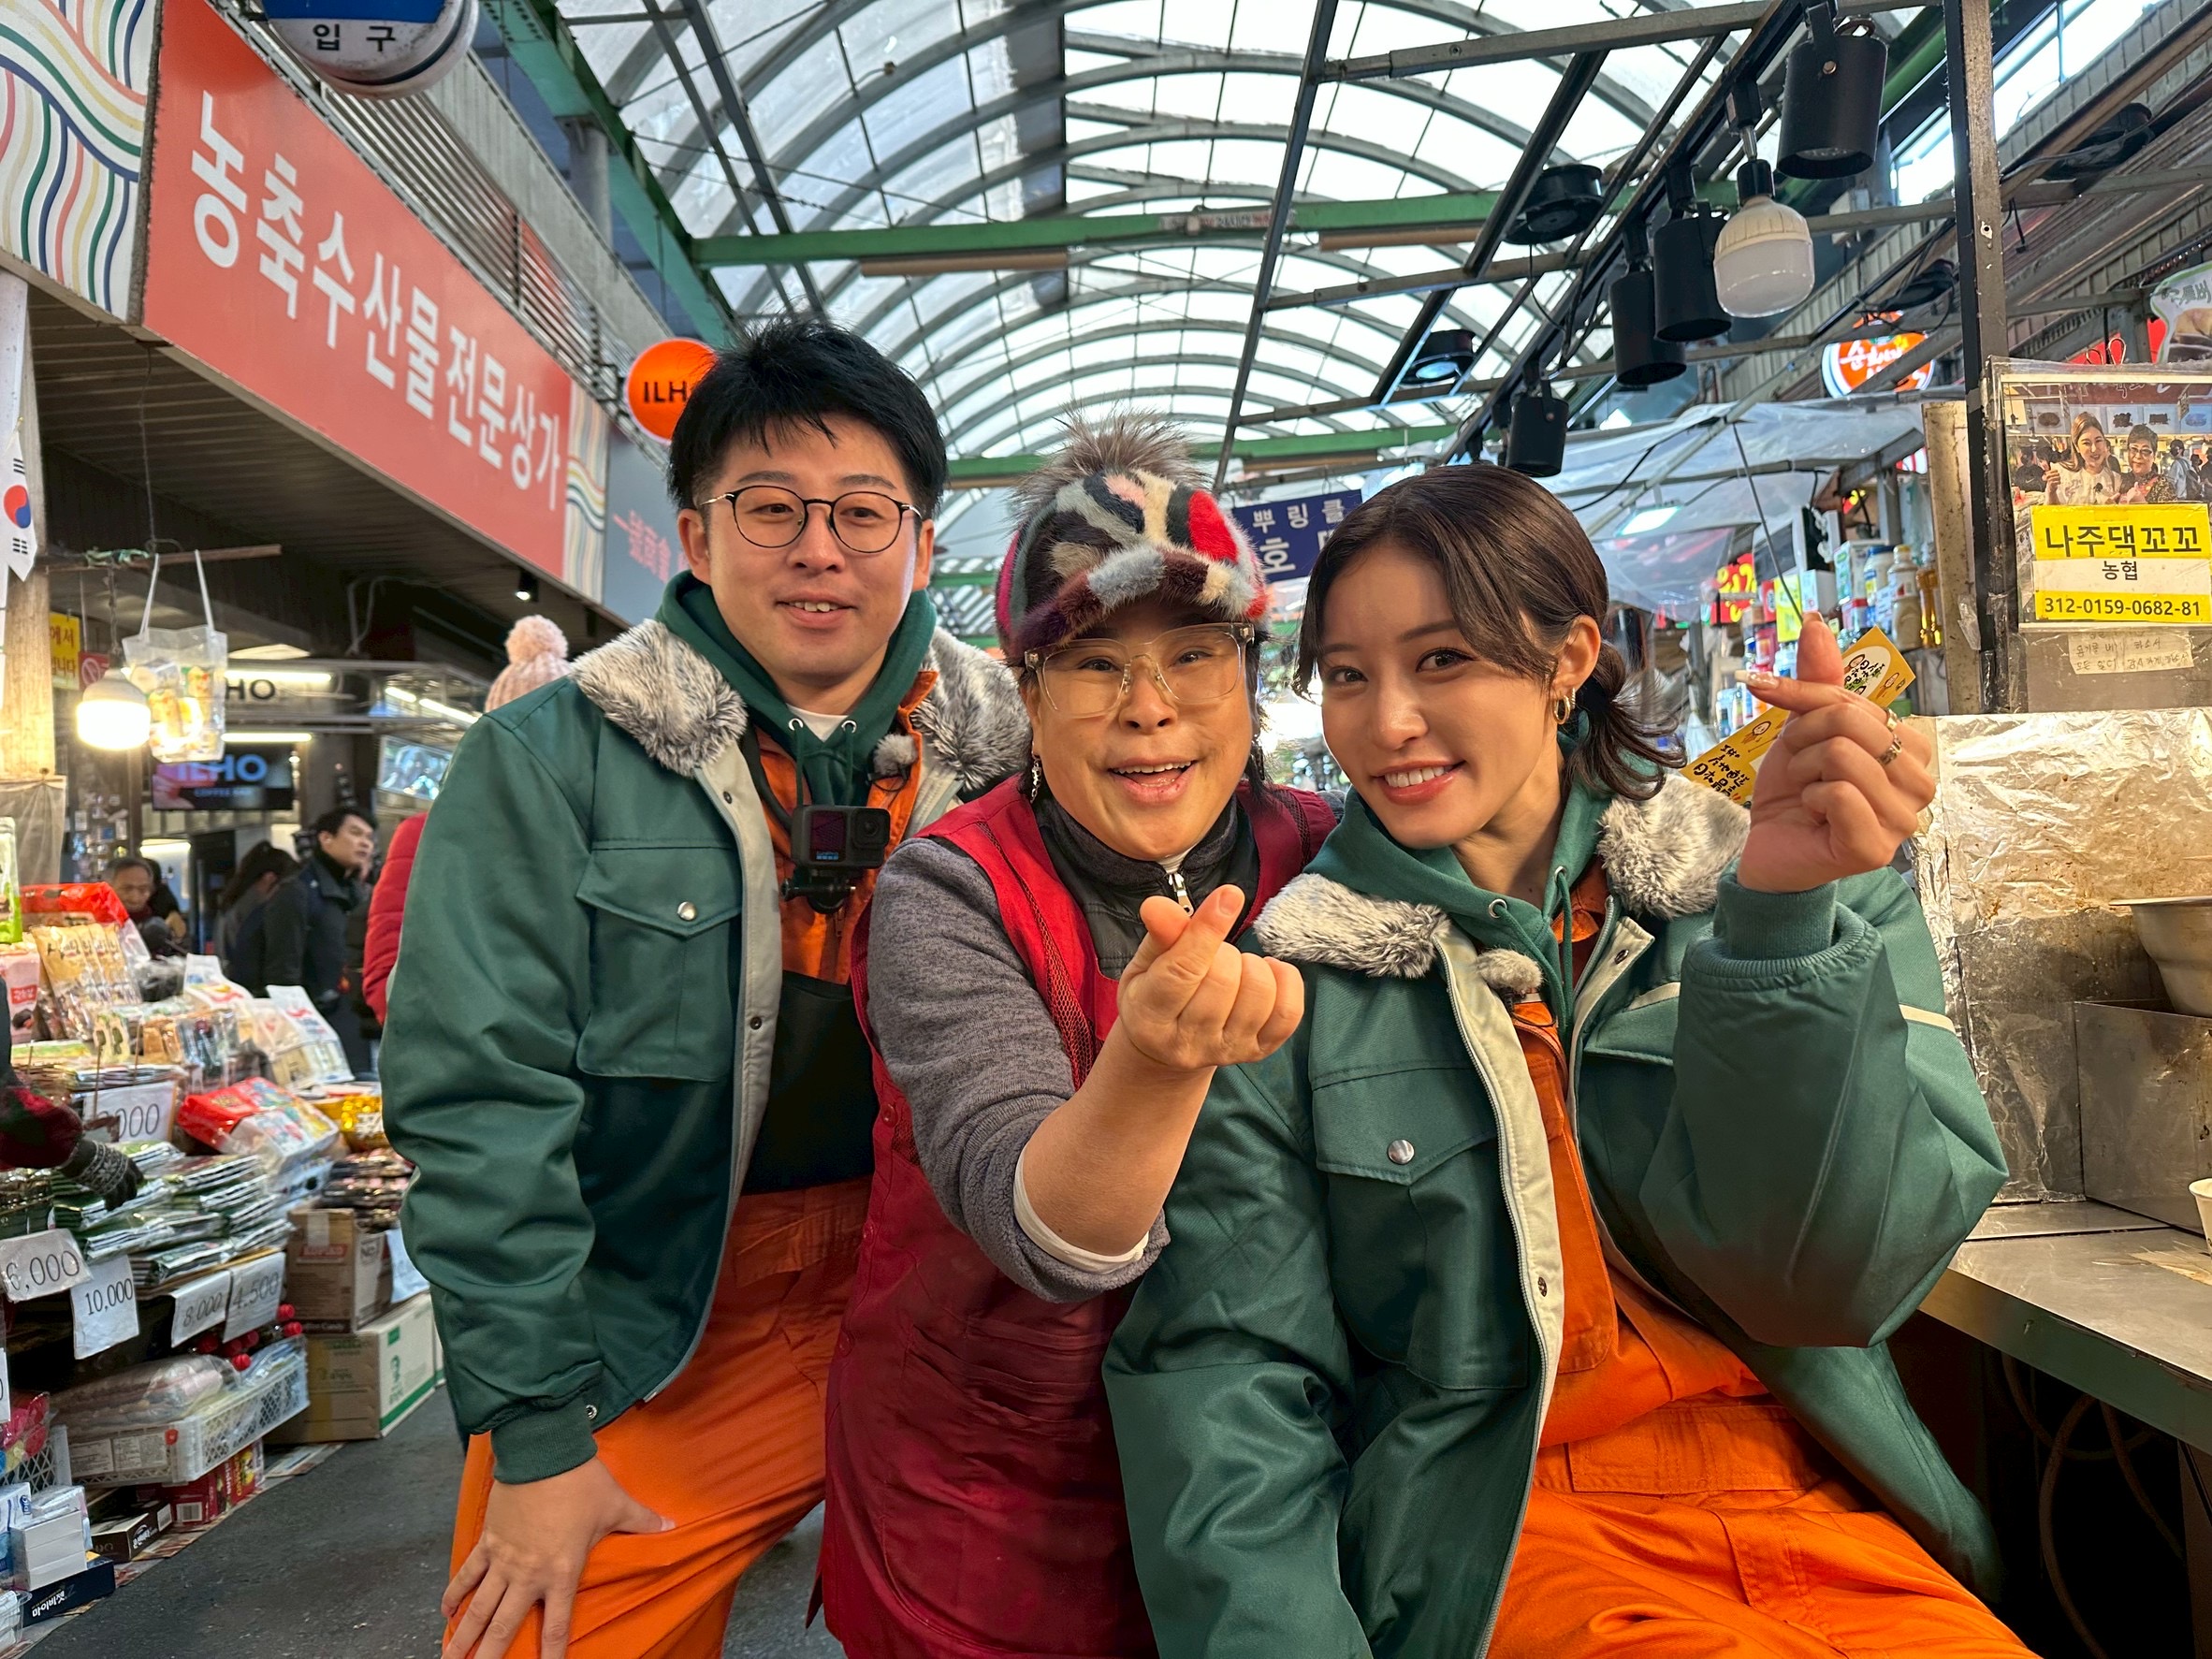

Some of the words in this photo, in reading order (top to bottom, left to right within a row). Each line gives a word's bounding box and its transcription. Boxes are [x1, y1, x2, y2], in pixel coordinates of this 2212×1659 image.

[313, 23, 396, 51] 입구
[191, 90, 561, 511] 농축수산물전문상가
[2045, 524, 2202, 558] 나주댁꼬꼬
[2102, 560, 2138, 581] 농협
[2045, 597, 2201, 617] 312-0159-0682-81
[6, 1250, 80, 1292] 6,000
[84, 1278, 134, 1316] 10,000
